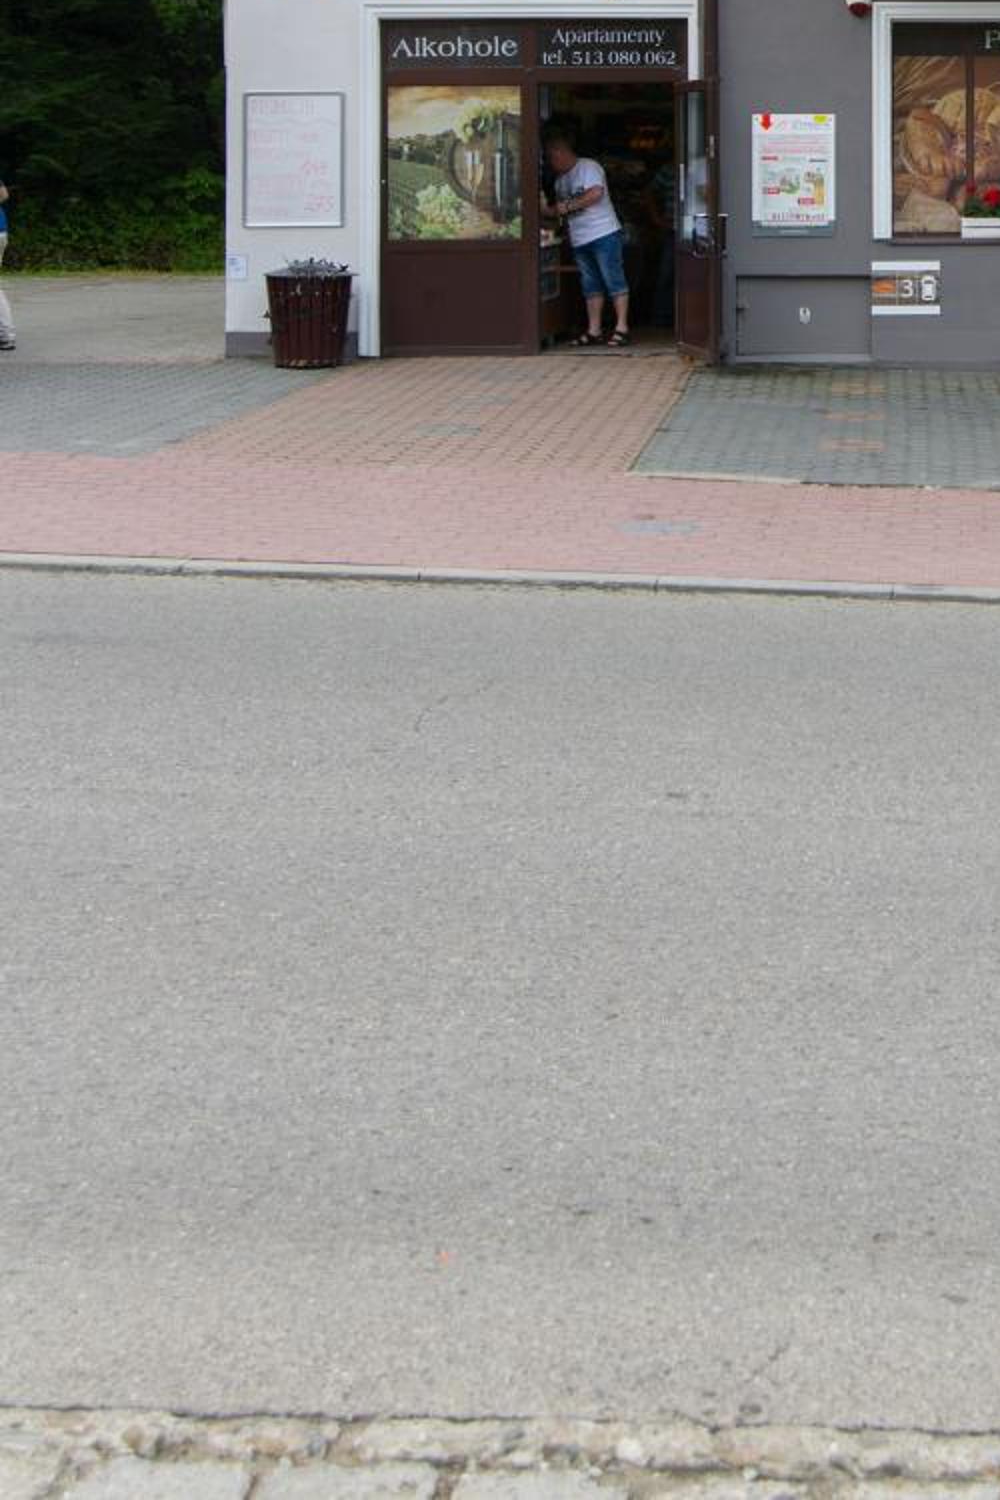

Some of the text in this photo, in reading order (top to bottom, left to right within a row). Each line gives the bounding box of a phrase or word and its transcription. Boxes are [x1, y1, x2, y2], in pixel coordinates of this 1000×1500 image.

[392, 35, 519, 59] Alkohole
[551, 28, 665, 48] Apartamenty
[543, 50, 676, 65] tel. 513 080 062
[901, 279, 914, 298] 3
